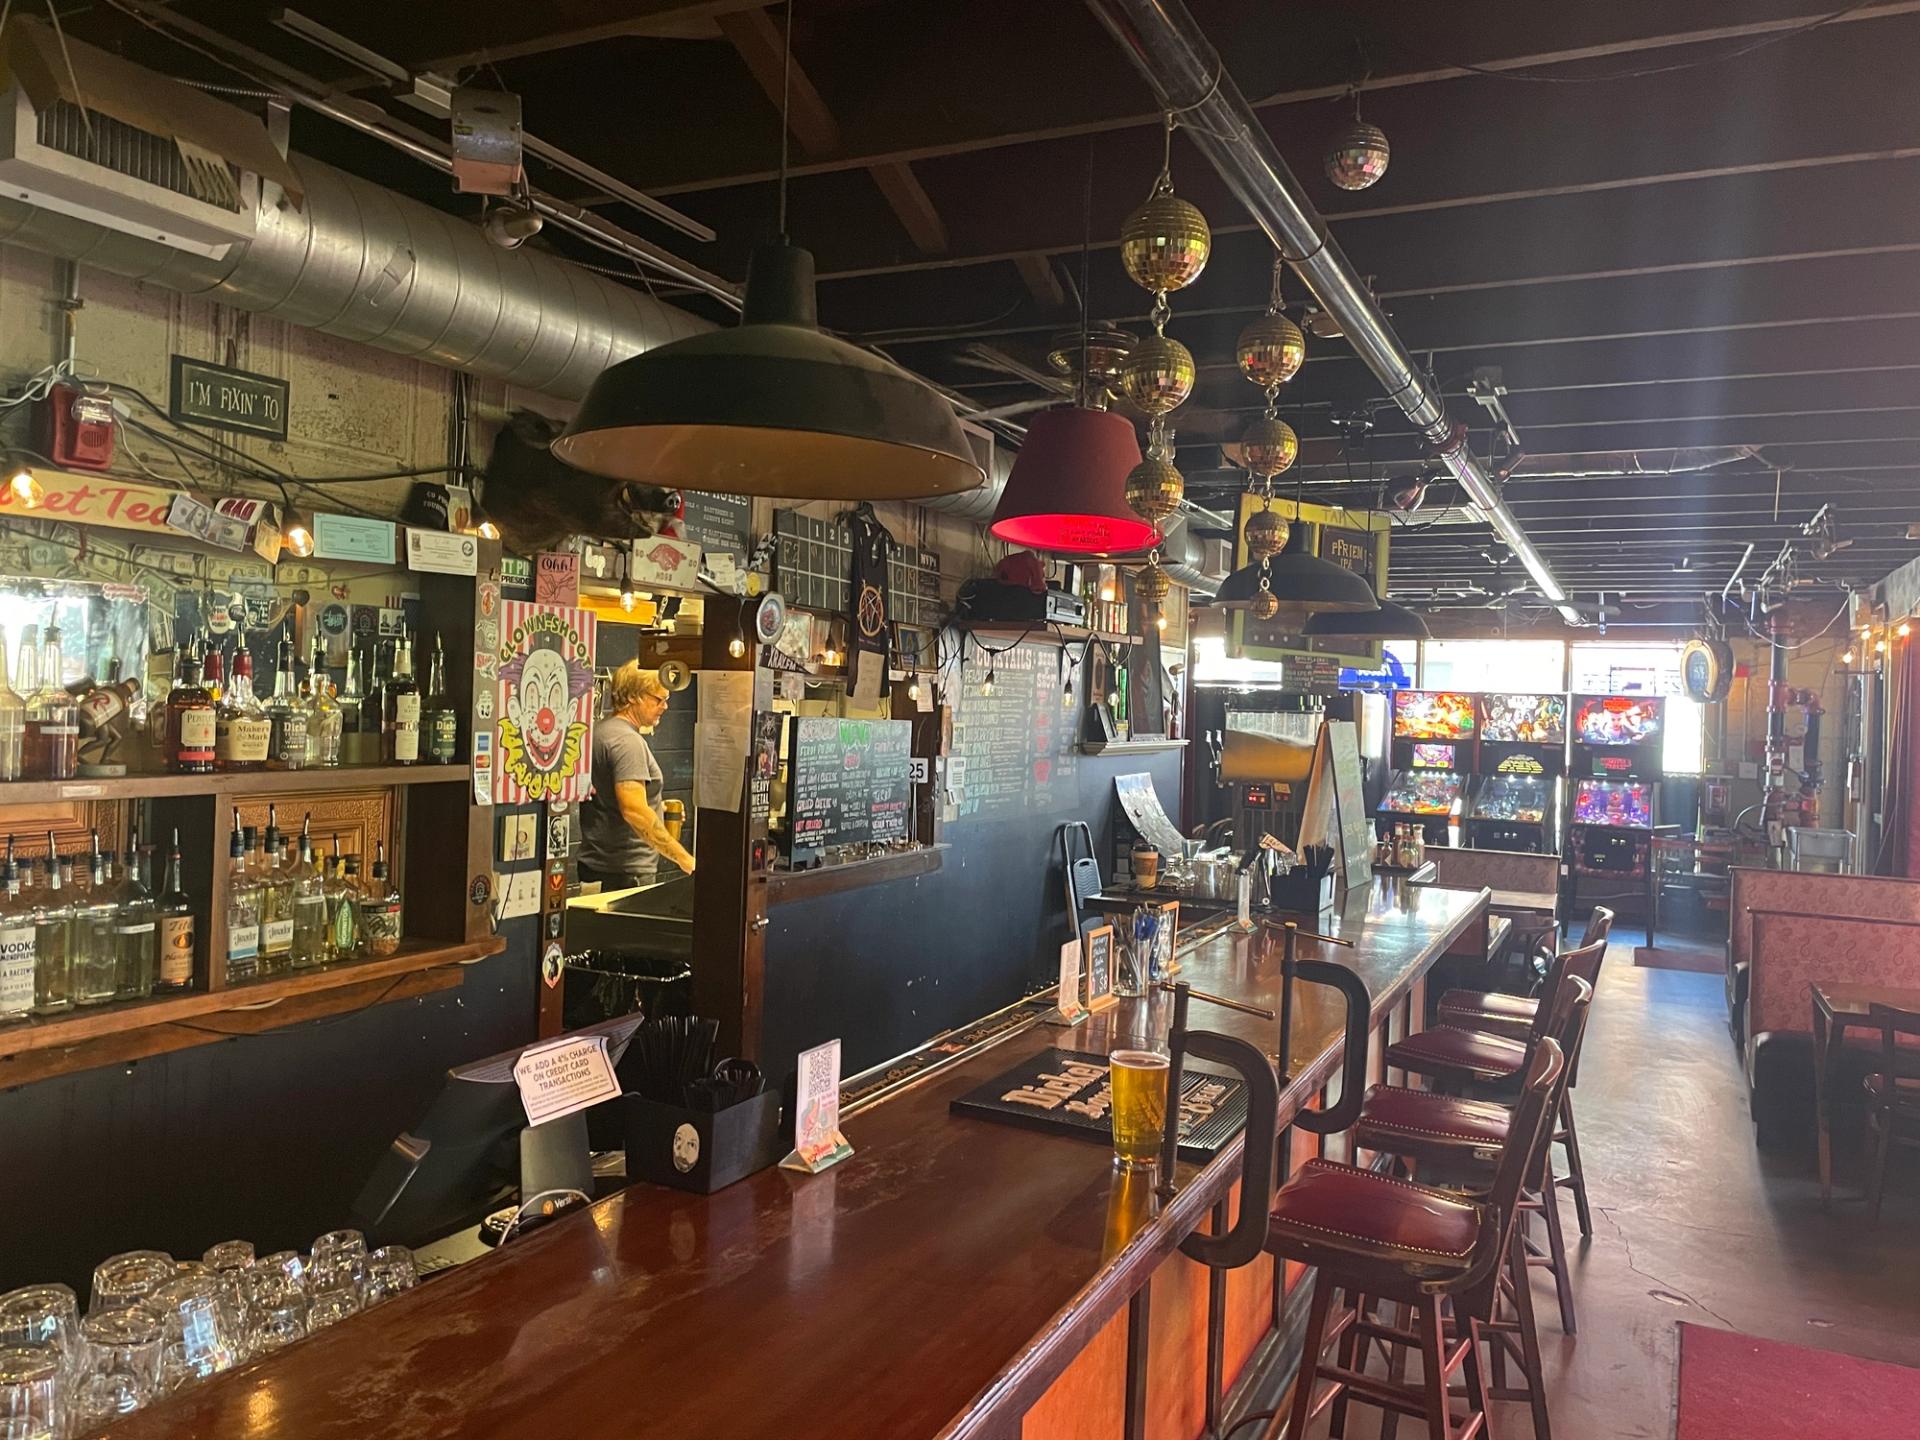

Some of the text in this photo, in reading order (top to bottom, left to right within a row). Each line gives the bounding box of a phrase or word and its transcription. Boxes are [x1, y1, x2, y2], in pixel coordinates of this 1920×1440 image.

[190, 381, 279, 420] I'M FIXIN' TO
[815, 524, 849, 545] 1 2 3
[541, 556, 574, 573] Ohh!
[977, 644, 1032, 670] COKTAILS
[751, 779, 770, 793] HEAVY
[751, 792, 770, 806] METAL
[519, 1044, 598, 1075] WE ADD A 4% CHARGE
[533, 1058, 589, 1082] ON CREDIT CARD
[539, 1067, 591, 1092] TRANSACTIONS
